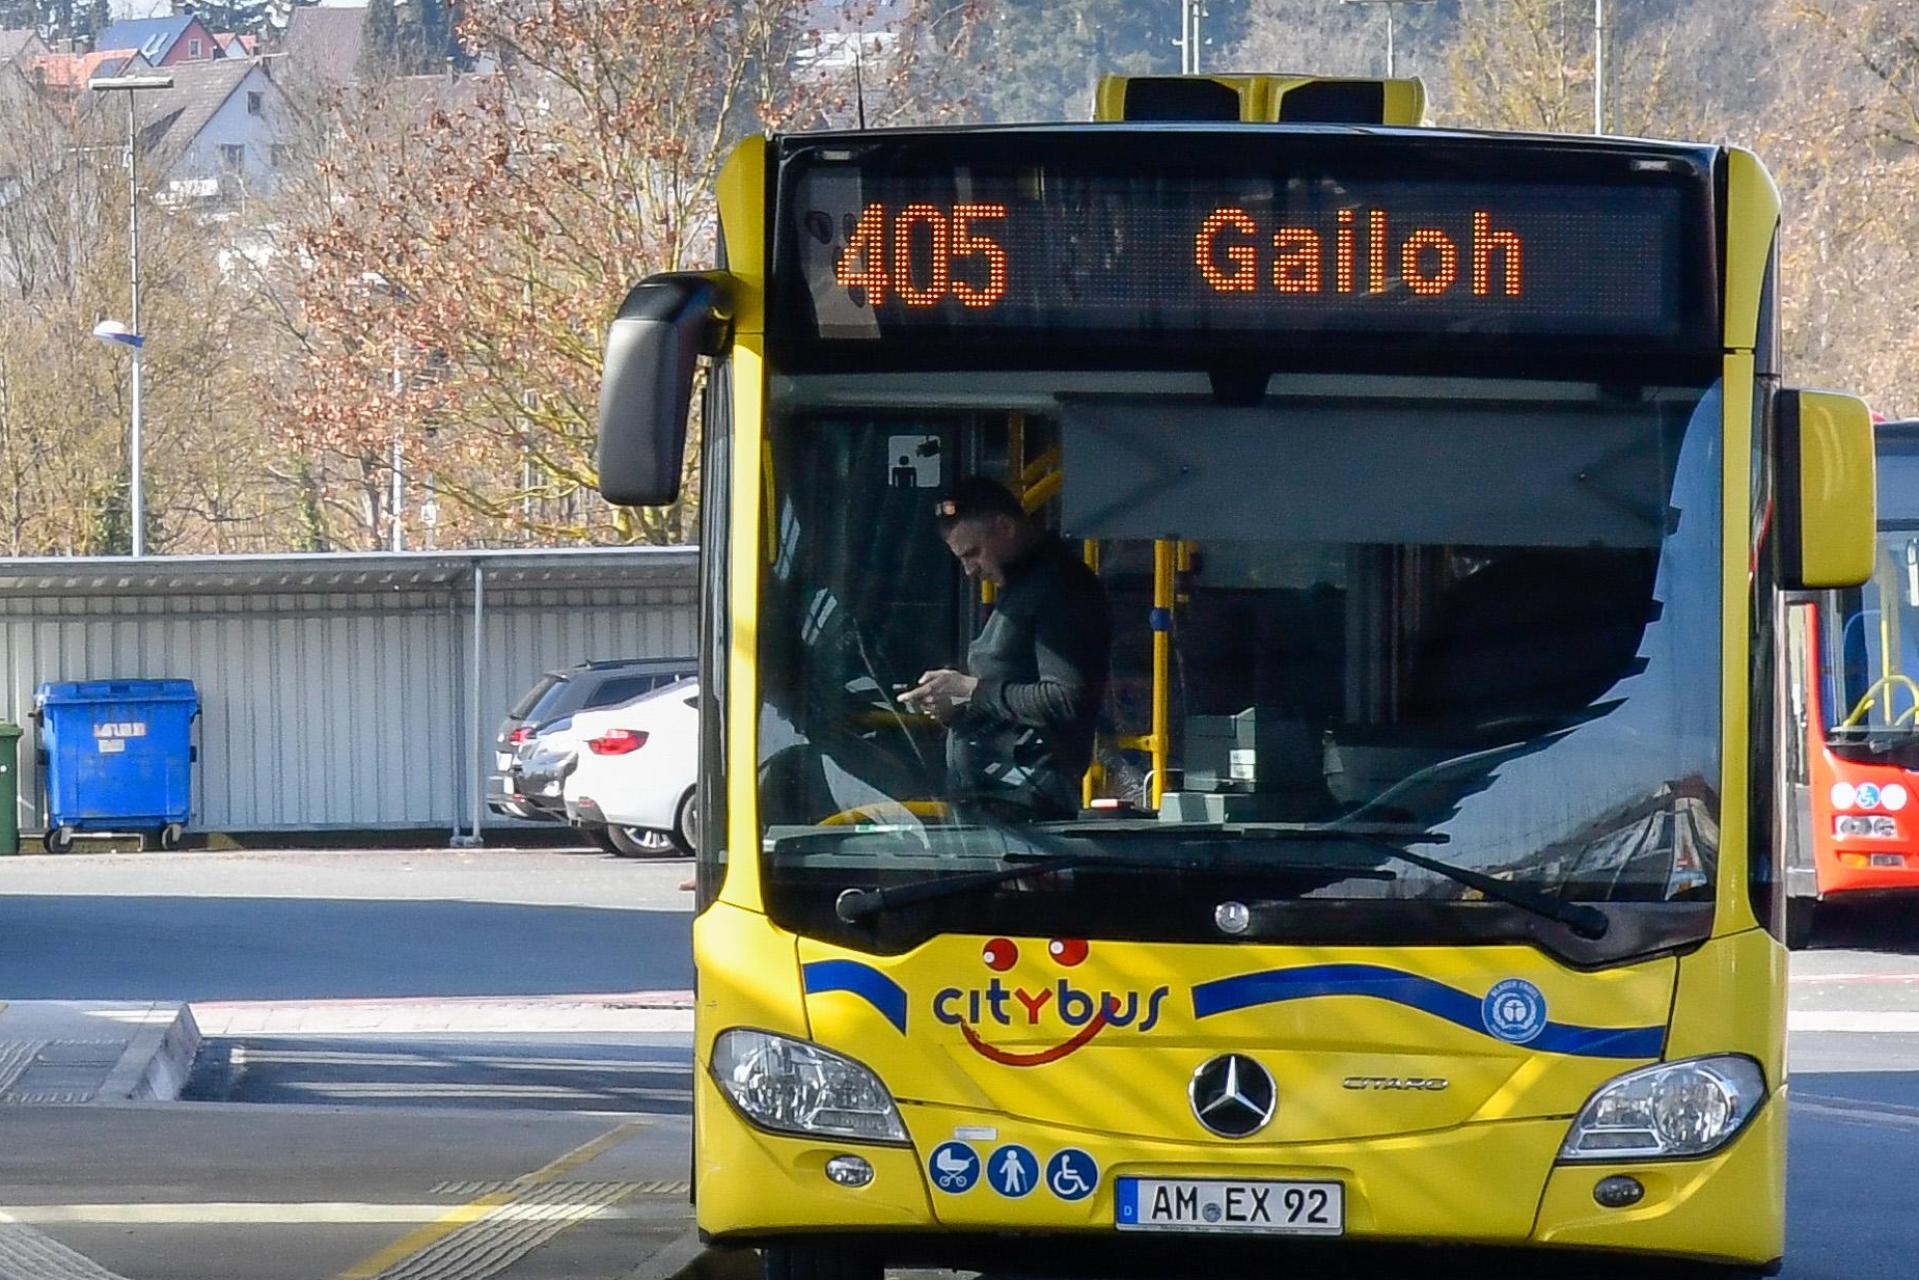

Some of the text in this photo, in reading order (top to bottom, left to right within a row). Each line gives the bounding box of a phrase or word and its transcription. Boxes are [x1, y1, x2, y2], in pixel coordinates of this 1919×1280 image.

[836, 203, 1523, 305] 405 Gailoh
[1343, 1076, 1449, 1091] CITARO
[1123, 1186, 1328, 1223] D AM EX 92
